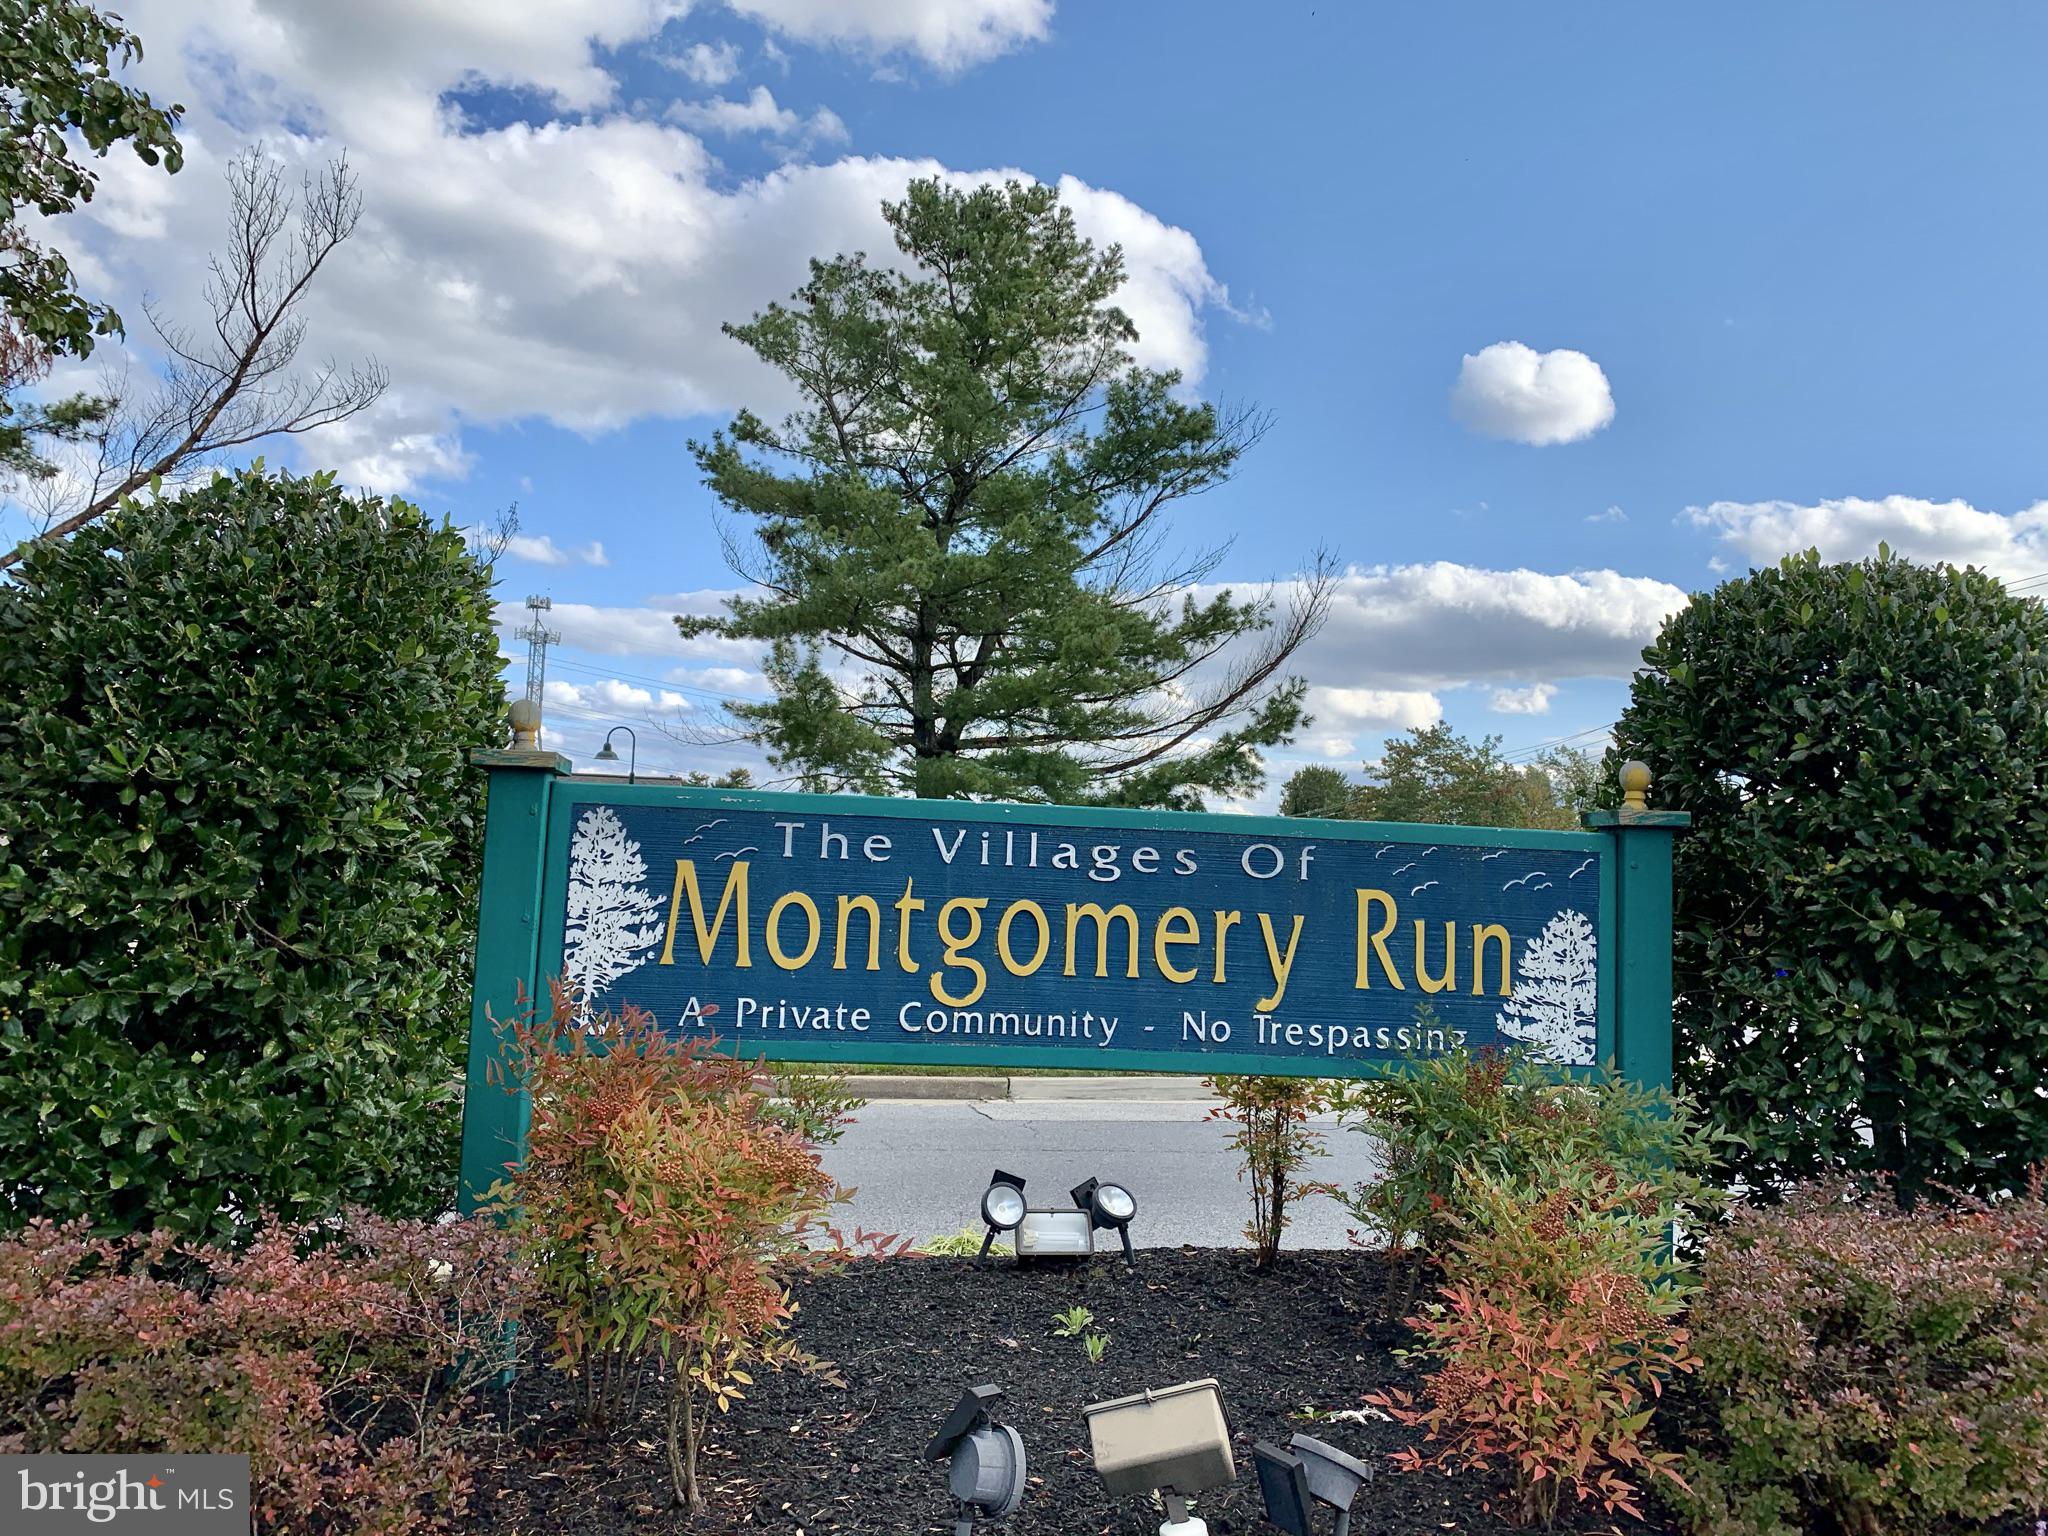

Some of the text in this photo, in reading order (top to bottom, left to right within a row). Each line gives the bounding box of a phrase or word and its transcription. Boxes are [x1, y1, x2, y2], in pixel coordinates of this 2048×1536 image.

[774, 821, 1317, 881] The Villages Of
[659, 859, 1513, 1012] Montgomery Run
[677, 996, 705, 1027] A
[736, 997, 871, 1031] Private
[899, 1001, 1119, 1047] Community
[1182, 1011, 1232, 1043] No
